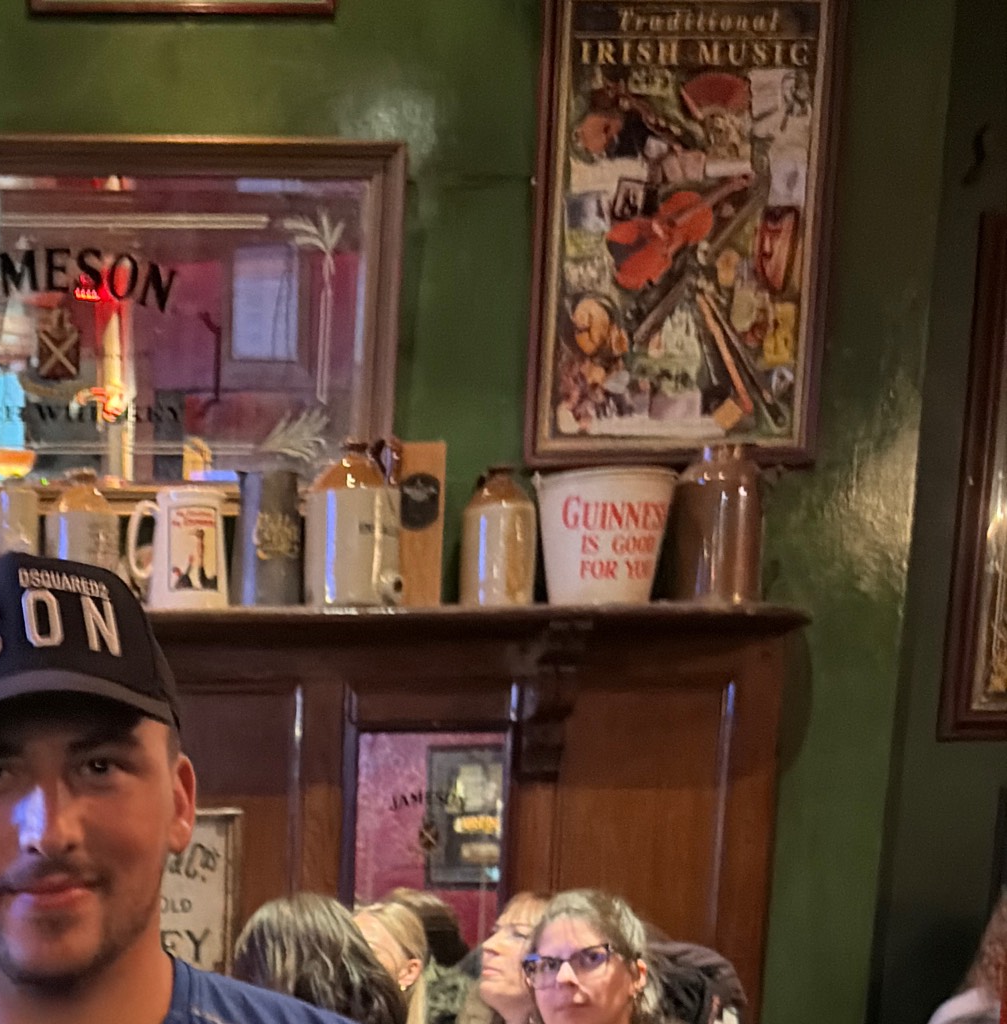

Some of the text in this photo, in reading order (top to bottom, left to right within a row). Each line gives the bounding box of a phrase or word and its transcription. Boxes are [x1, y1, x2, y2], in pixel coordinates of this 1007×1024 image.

[619, 6, 780, 32] Traditional
[580, 41, 810, 66] IRISH MUSIC
[581, 535, 598, 555] IS
[580, 560, 618, 580] FOR
